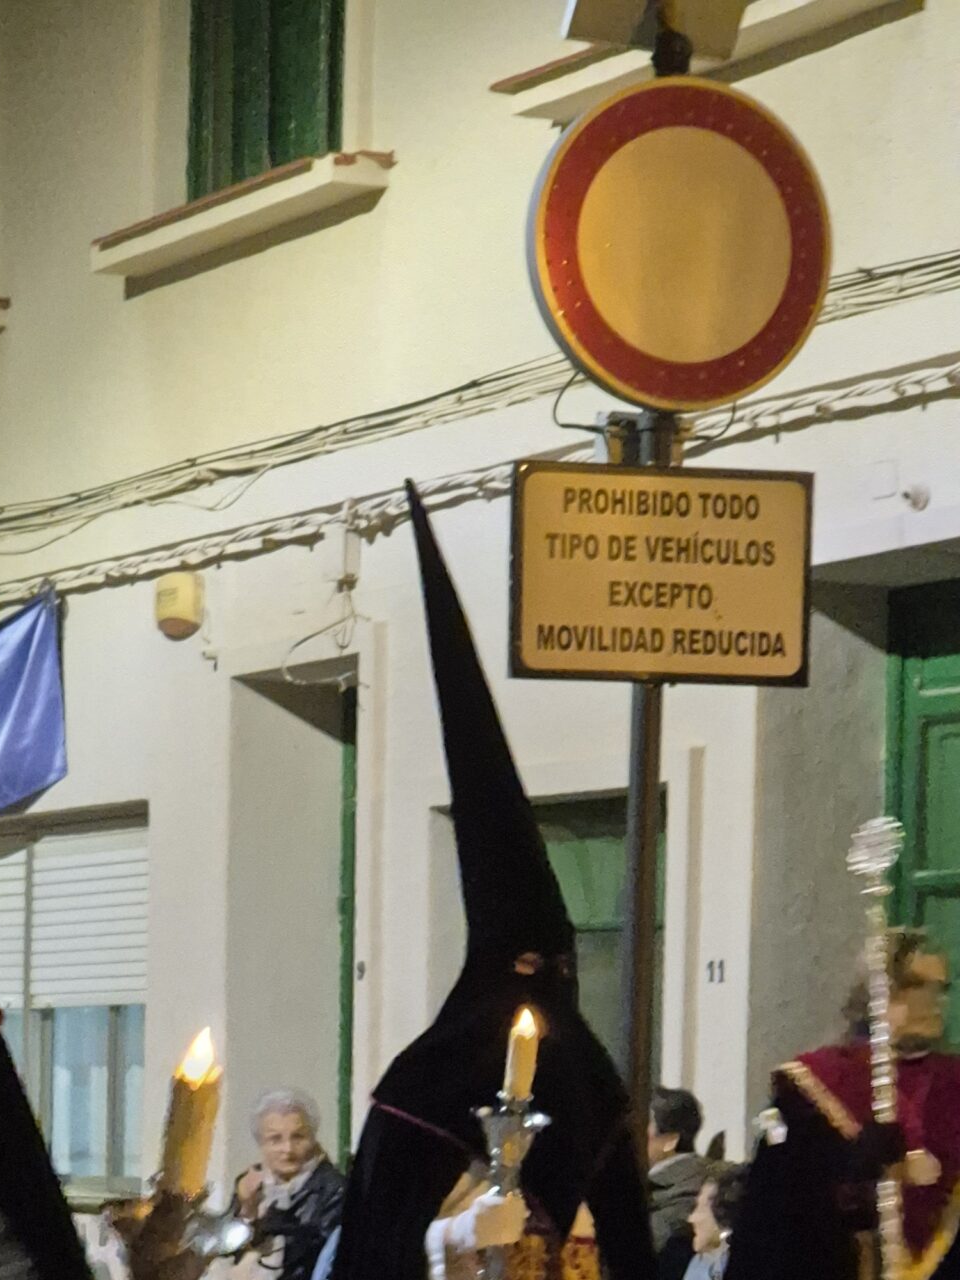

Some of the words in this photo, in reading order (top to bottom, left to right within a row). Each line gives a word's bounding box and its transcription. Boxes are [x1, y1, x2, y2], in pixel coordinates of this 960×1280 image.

[563, 486, 690, 518] PROHIBIDO
[698, 493, 760, 520] TODO
[545, 533, 599, 560] TIPO
[607, 534, 638, 562] DE
[645, 531, 776, 567] VEHÍCULOS
[608, 581, 713, 610] EXCEPTO
[537, 624, 665, 654] MOVILIDAD
[672, 628, 787, 658] REDUCIDA
[706, 959, 725, 983] 11
